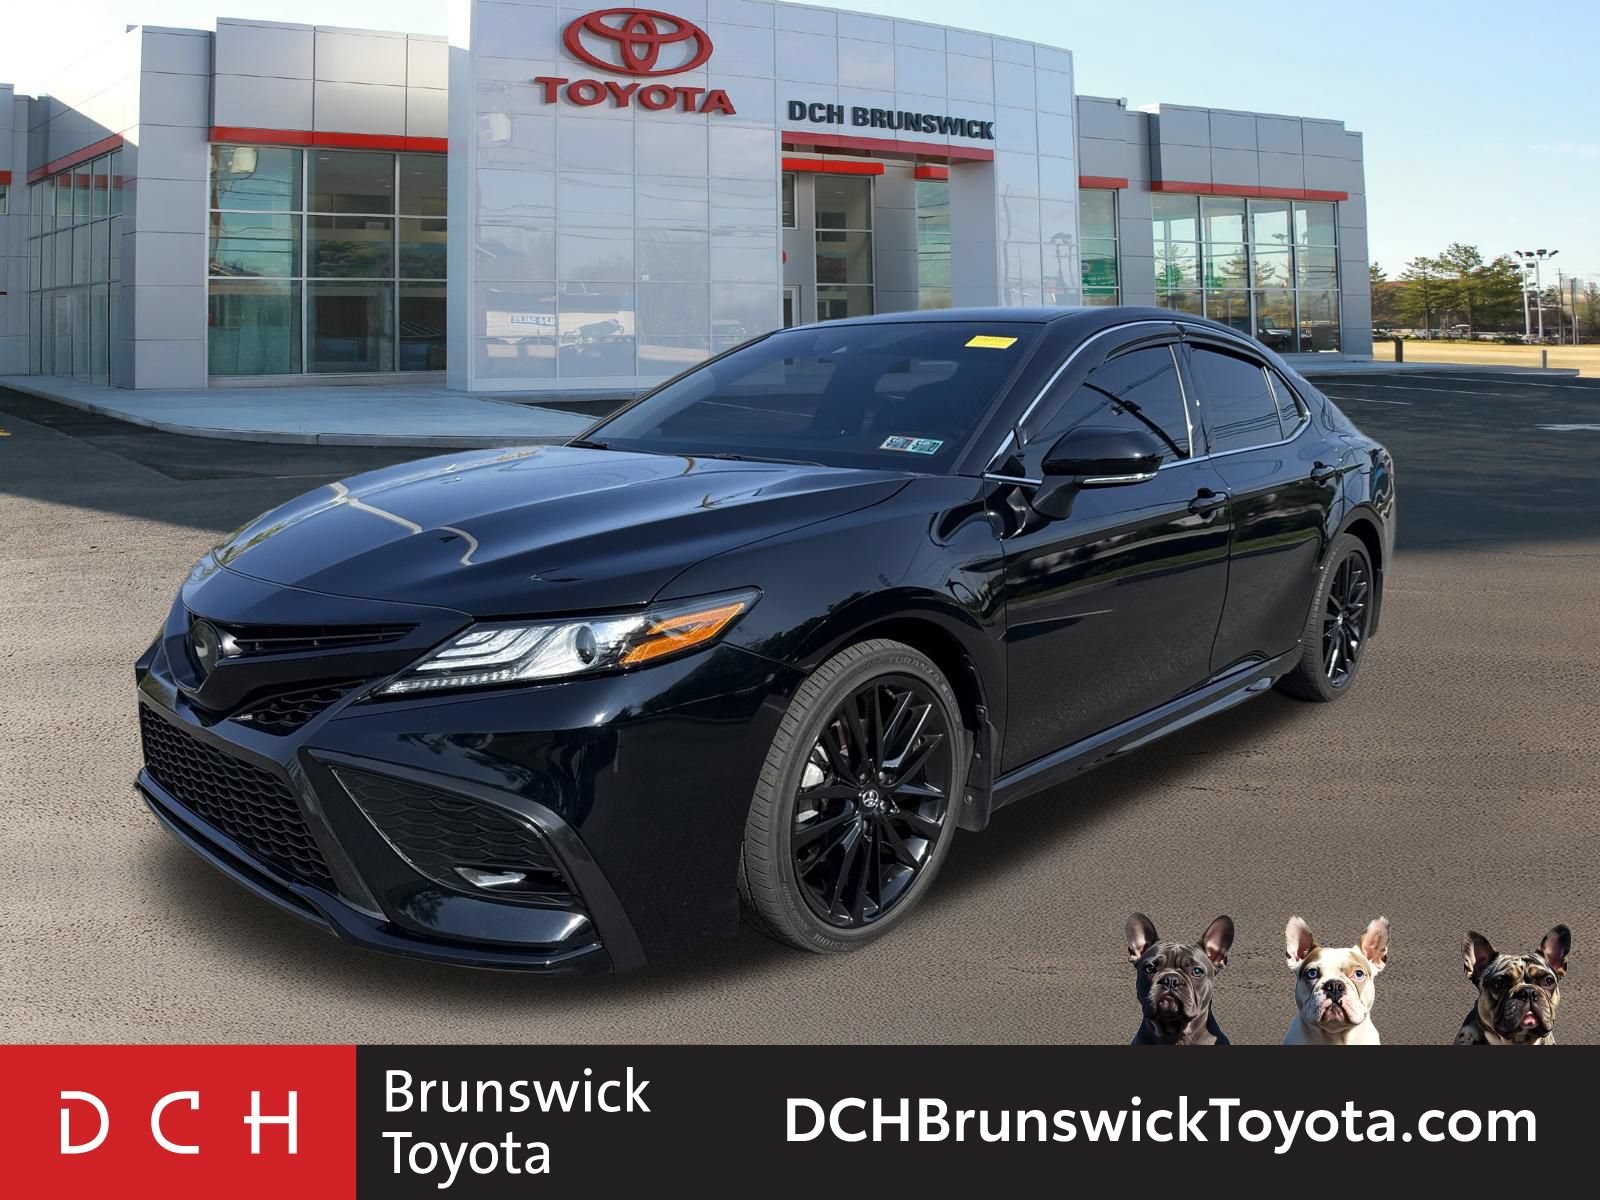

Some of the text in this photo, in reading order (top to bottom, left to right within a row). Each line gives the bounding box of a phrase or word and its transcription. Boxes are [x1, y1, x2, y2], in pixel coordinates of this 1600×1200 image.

[534, 75, 736, 115] TOYOTA
[787, 100, 995, 141] DCH BRUNSWICK
[887, 655, 940, 681] TURANZA
